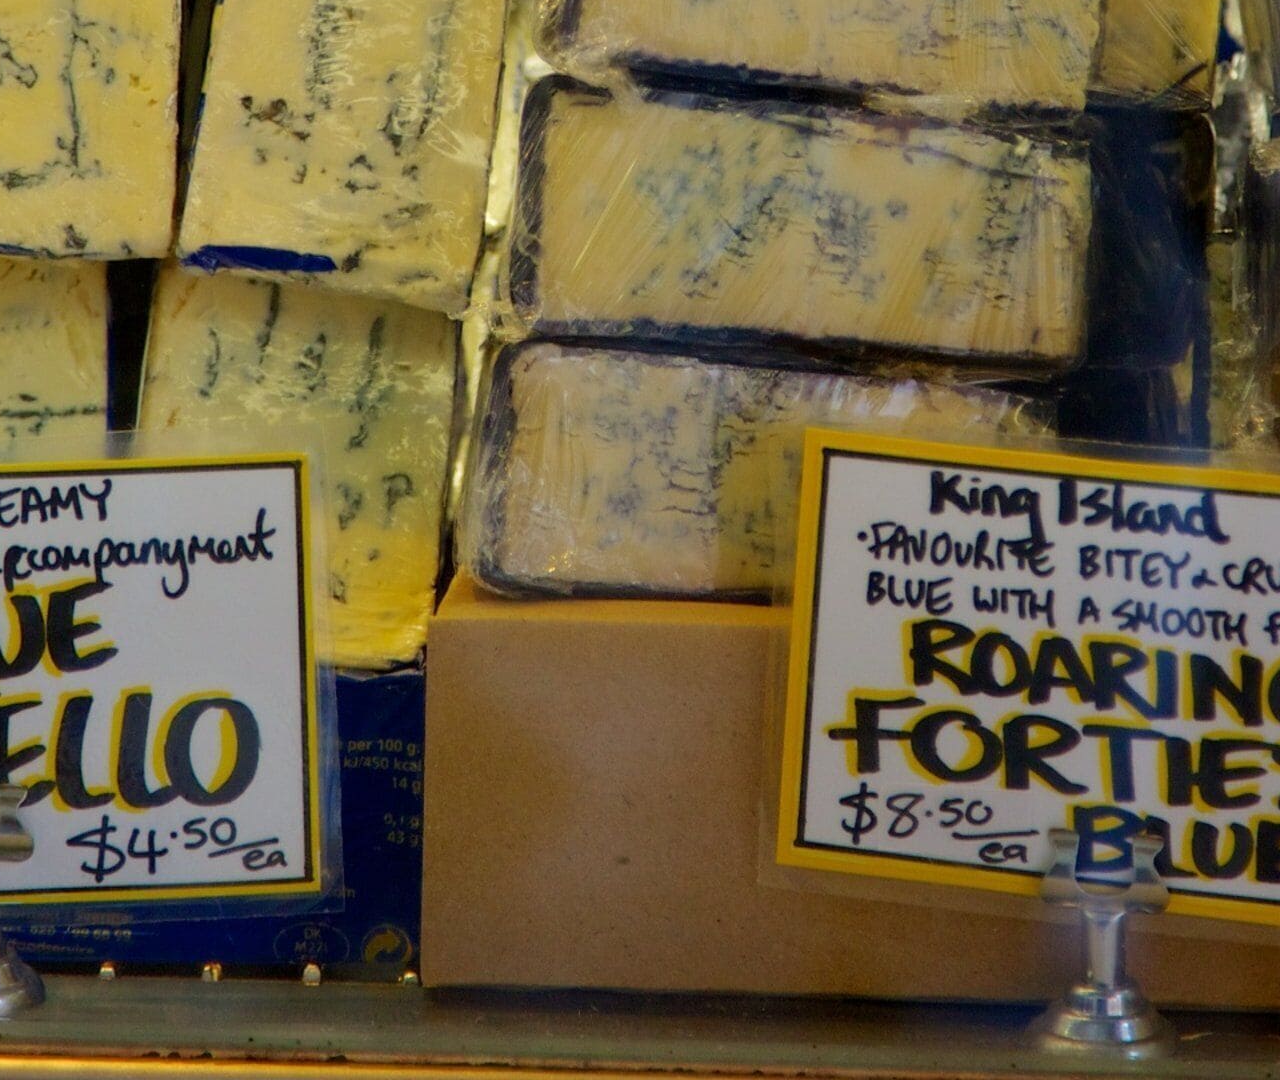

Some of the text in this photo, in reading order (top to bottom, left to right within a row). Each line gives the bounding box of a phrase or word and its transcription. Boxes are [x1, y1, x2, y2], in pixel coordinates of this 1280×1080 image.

[929, 470, 1231, 544] King Island
[867, 521, 1056, 578] FAVOURITE
[1078, 543, 1192, 589] BITEY
[866, 571, 954, 616] BLUE
[973, 585, 1056, 628] WITH
[1077, 596, 1102, 624] A
[1111, 599, 1247, 646] SMOOTH
[377, 738, 404, 753] 100
